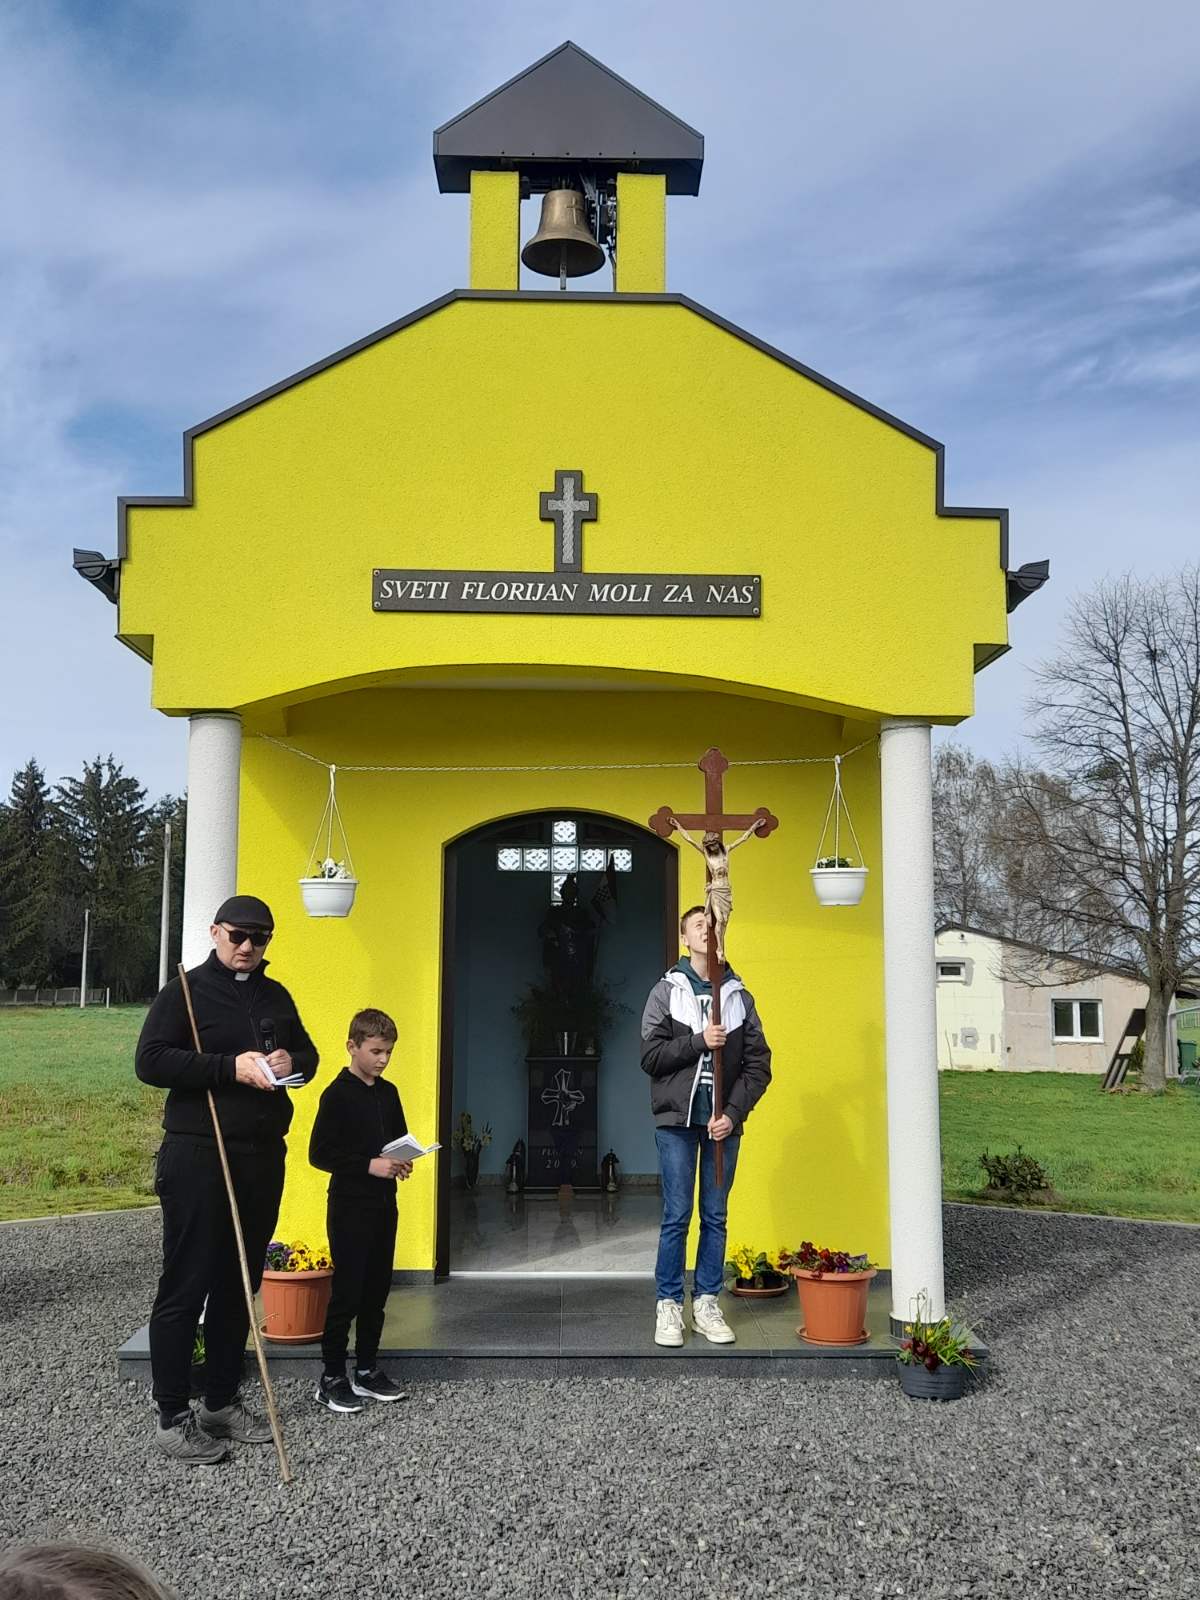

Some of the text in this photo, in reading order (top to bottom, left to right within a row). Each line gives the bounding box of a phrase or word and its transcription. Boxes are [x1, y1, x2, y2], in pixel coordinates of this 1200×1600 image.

[380, 579, 755, 604] SVETI FLORIJAN MOLI ZA NAS
